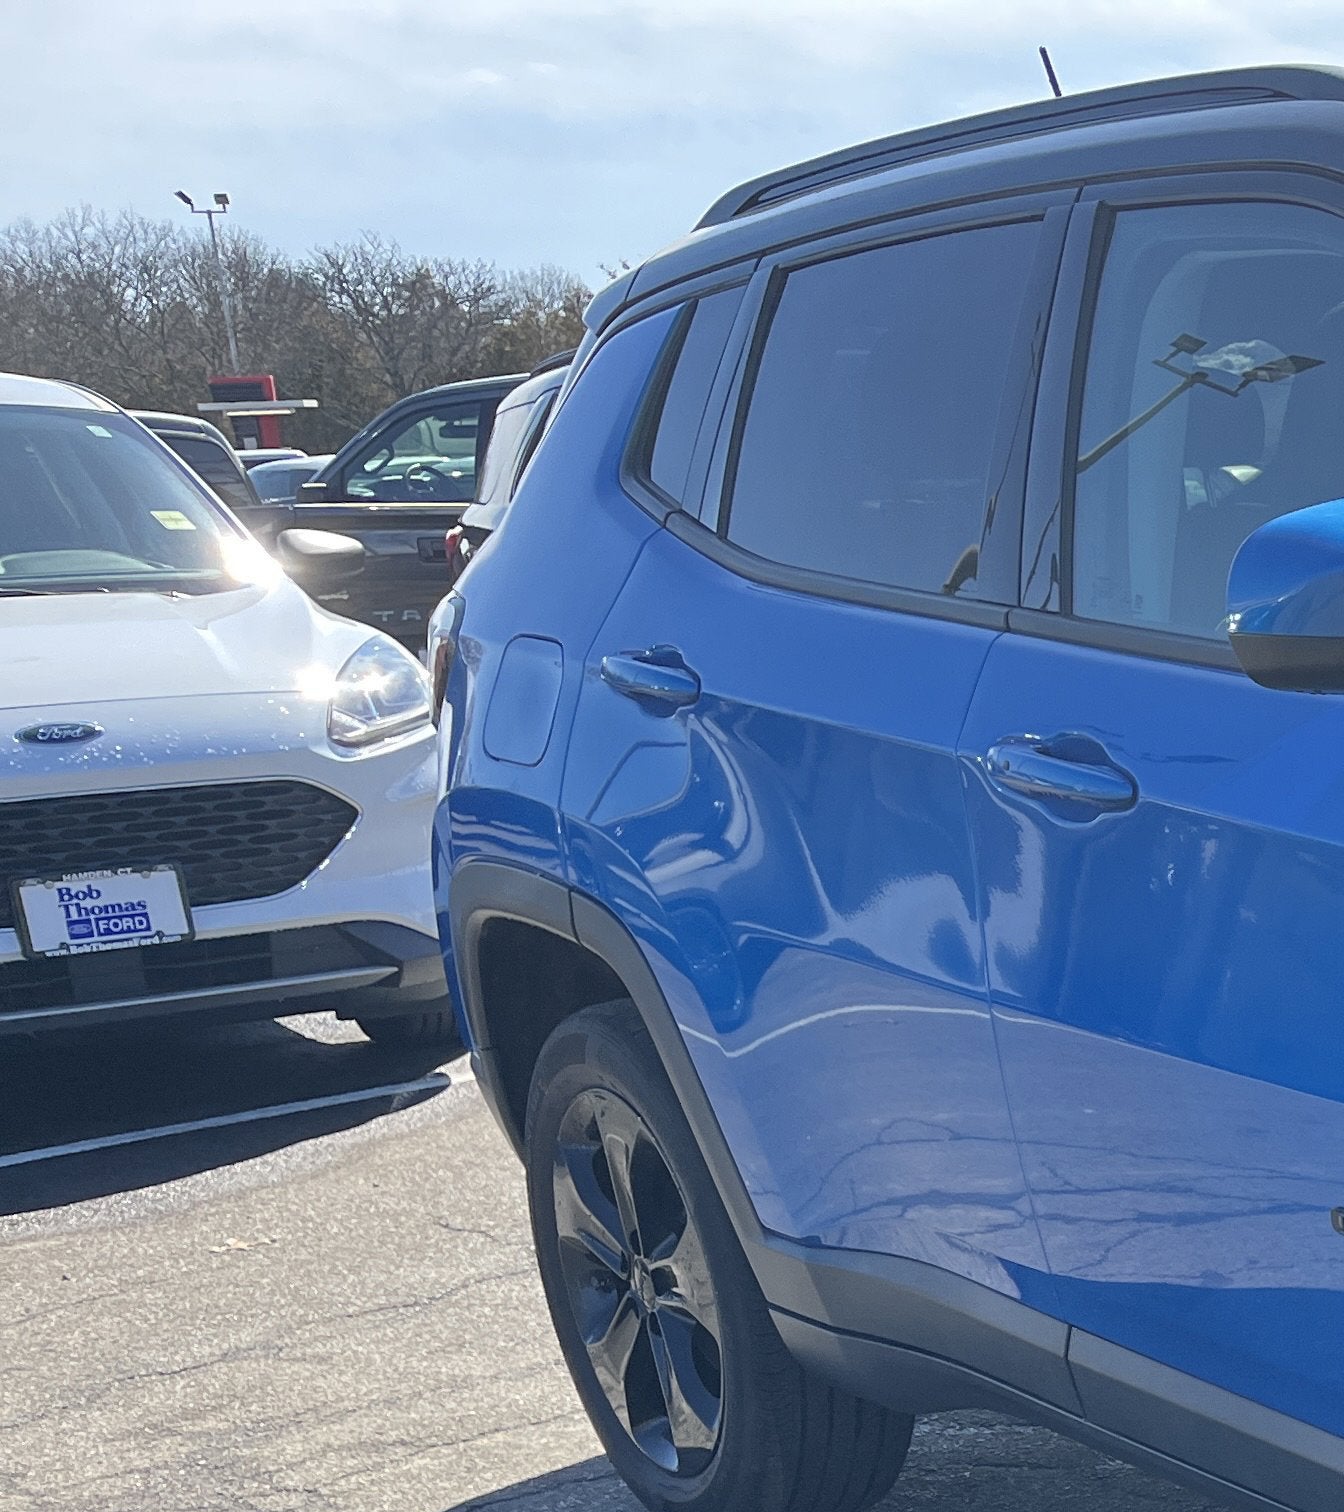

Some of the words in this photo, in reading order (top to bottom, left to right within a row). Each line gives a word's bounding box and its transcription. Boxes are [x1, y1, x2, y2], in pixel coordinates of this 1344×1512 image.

[36, 726, 85, 741] Ford
[56, 884, 102, 903] Bob
[58, 899, 148, 920] Thomas
[98, 915, 148, 934] FORD
